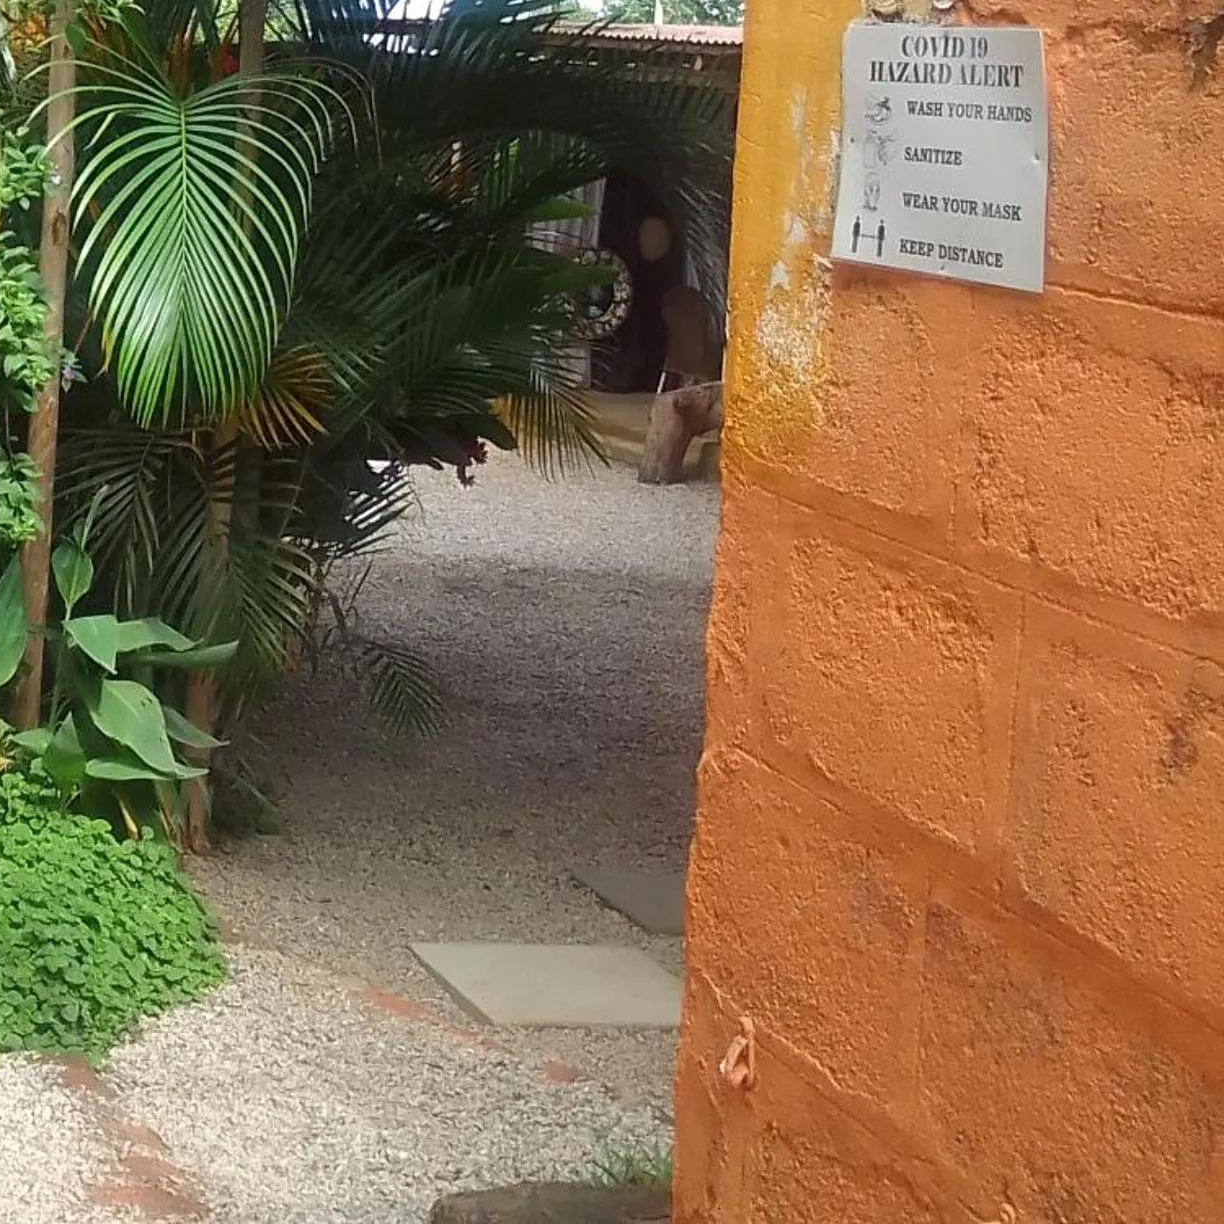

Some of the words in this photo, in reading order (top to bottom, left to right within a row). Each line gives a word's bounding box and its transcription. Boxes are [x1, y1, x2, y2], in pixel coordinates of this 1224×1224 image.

[901, 34, 964, 58] COVID
[970, 36, 988, 59] 19
[869, 60, 952, 85] HAZARD
[954, 64, 1024, 88] ALERT
[907, 100, 943, 118] WASH
[947, 102, 983, 120] YOUR
[987, 105, 1033, 123] HANDS
[904, 146, 962, 166] SANITIZE
[902, 192, 938, 211] WEAR
[942, 196, 978, 216] YOUR
[982, 201, 1022, 221] MASK
[899, 238, 934, 257] KEEP
[938, 244, 1004, 268] DISTANCE
